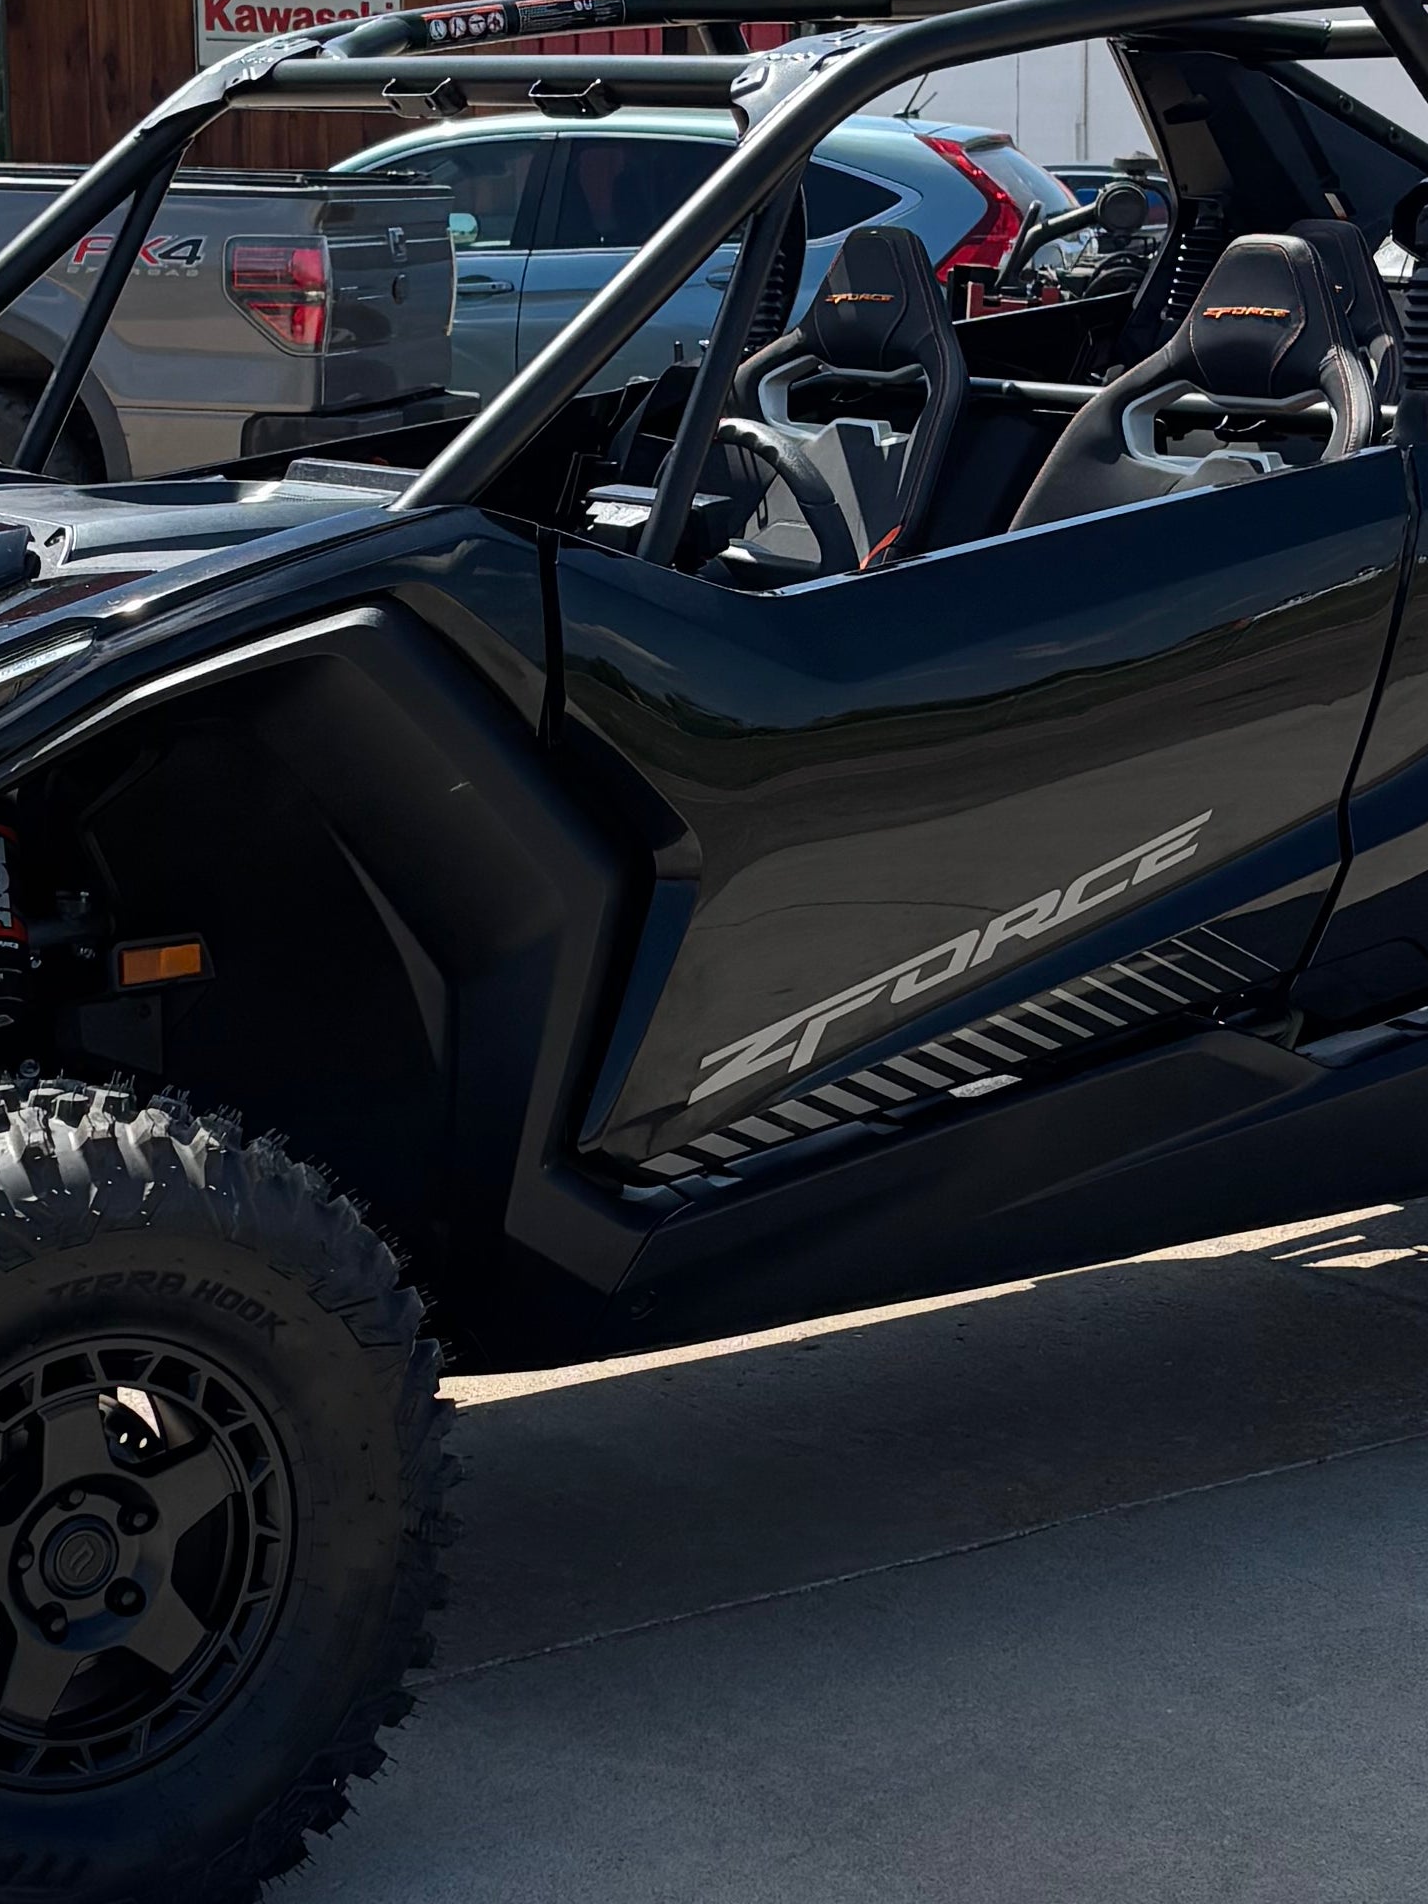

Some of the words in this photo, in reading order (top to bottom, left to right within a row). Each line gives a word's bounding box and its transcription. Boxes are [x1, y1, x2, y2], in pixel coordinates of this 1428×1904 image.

[687, 809, 1213, 1106] ZFORCE
[47, 1269, 187, 1298] TERRA
[191, 1278, 288, 1341] HOOK
